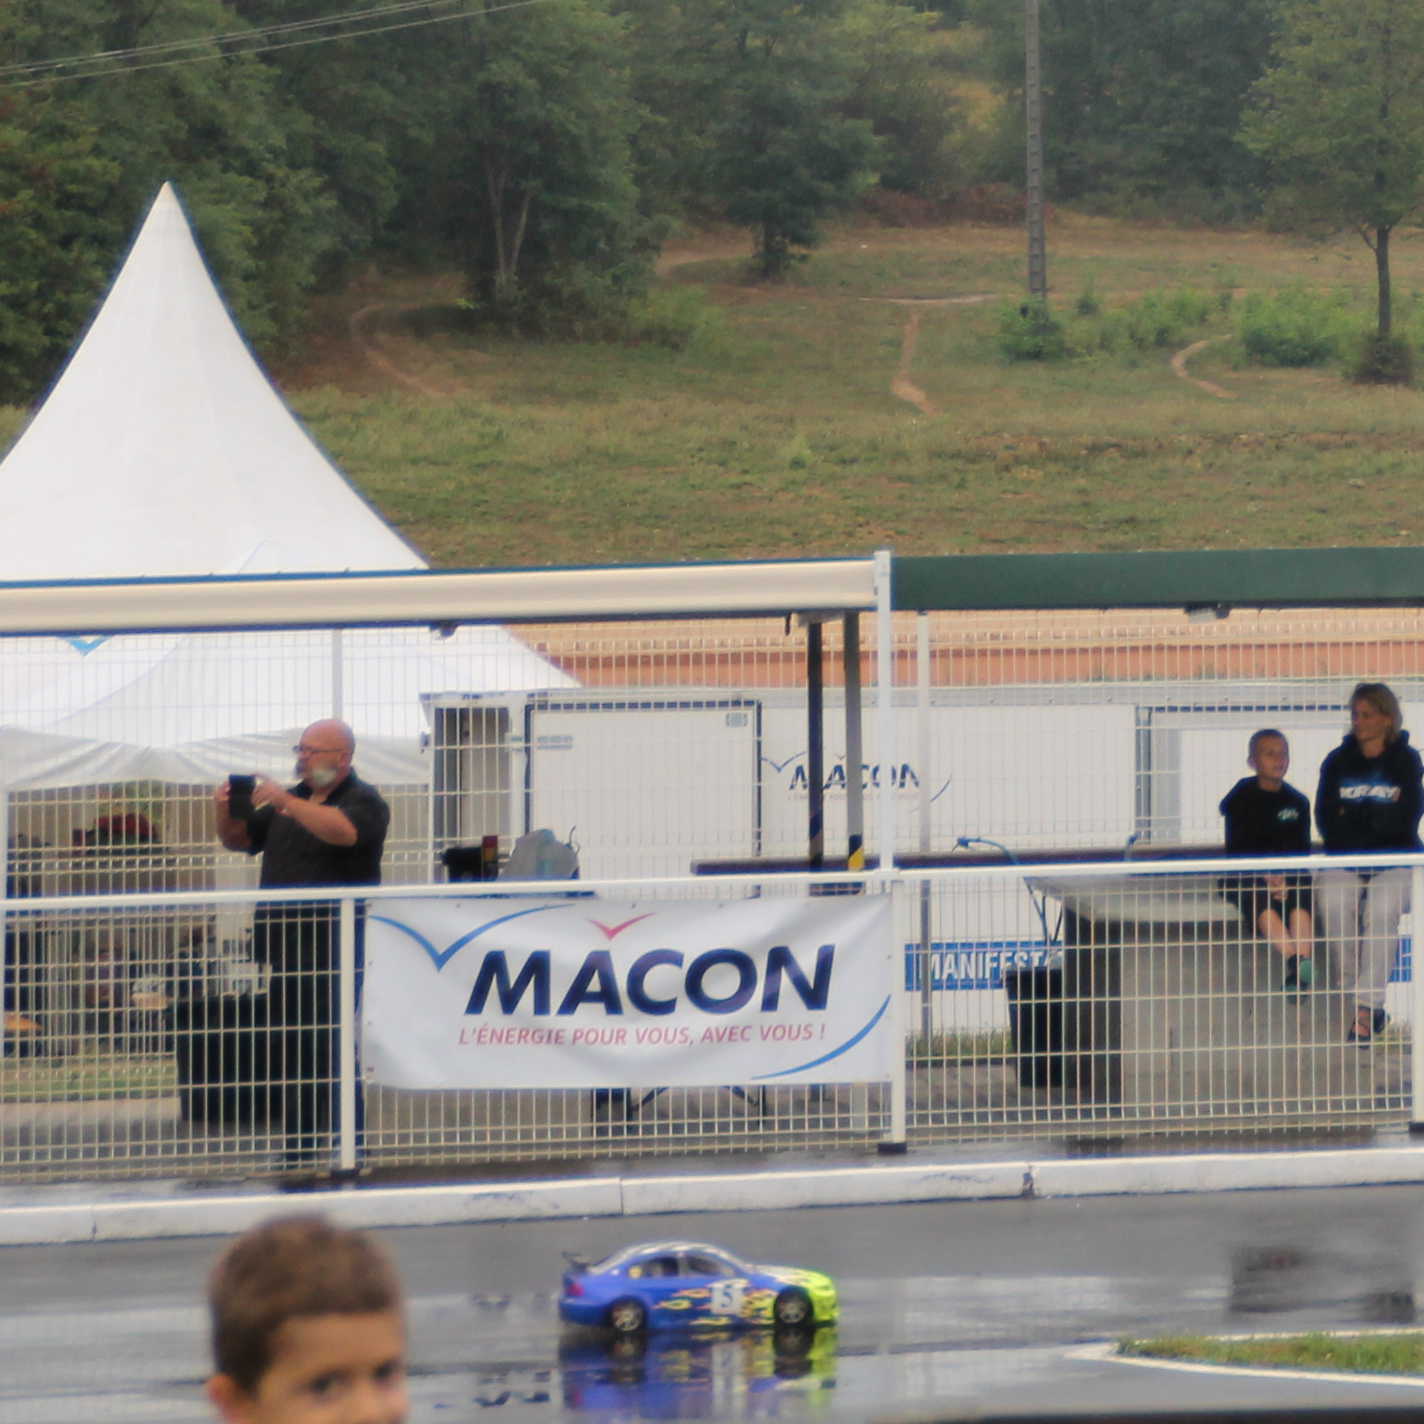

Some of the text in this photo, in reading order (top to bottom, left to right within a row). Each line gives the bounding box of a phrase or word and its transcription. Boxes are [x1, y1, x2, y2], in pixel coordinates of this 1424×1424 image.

[463, 944, 836, 1016] MACON
[458, 1023, 566, 1046] L'ÉNERGIE
[571, 1027, 627, 1045] POUR
[634, 1026, 694, 1046] VOUS,
[700, 1025, 752, 1043] AVEC
[759, 1023, 813, 1041] VOUS
[720, 1283, 734, 1308] 5
